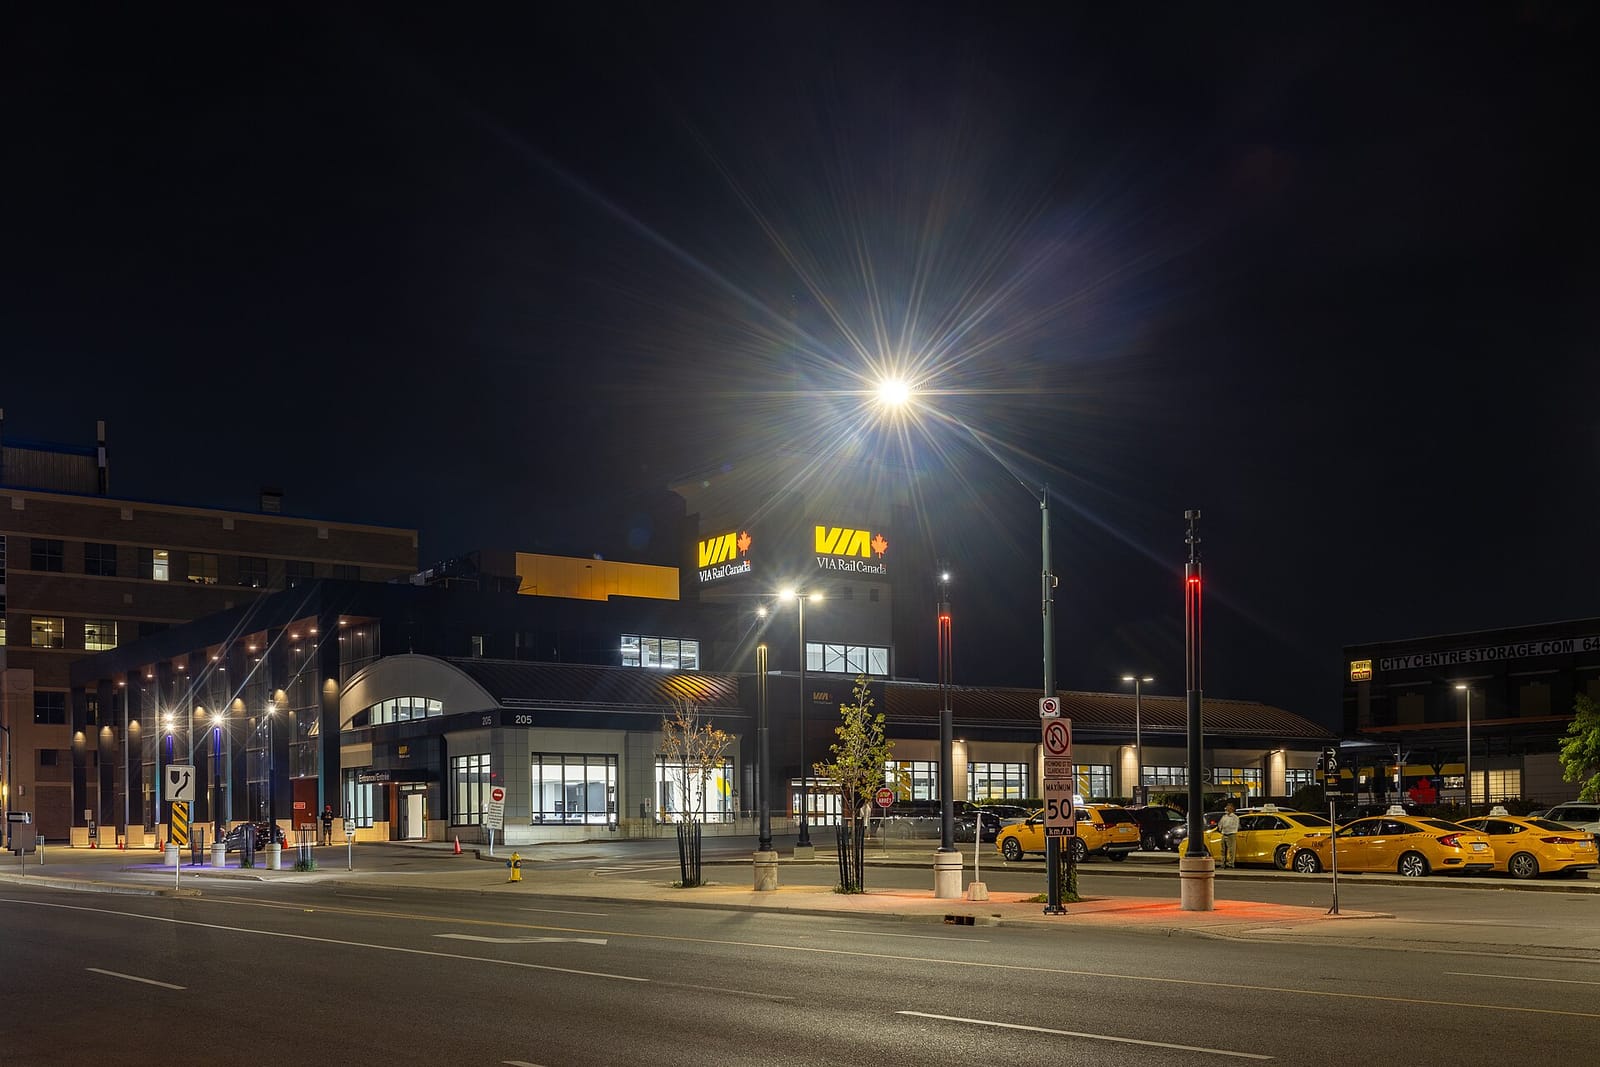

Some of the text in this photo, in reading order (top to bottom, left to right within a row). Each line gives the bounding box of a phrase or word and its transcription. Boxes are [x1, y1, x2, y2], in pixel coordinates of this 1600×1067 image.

[699, 532, 737, 568] VIA
[815, 526, 871, 558] VIA
[700, 561, 751, 583] VIA Rail Canada
[817, 557, 887, 575] VIA Rail Canada
[1382, 657, 1411, 670] CITY
[1413, 651, 1467, 667] CENTRE
[1470, 640, 1574, 661] STORAGE.COM
[515, 715, 532, 724] 205
[1047, 799, 1071, 820] 50
